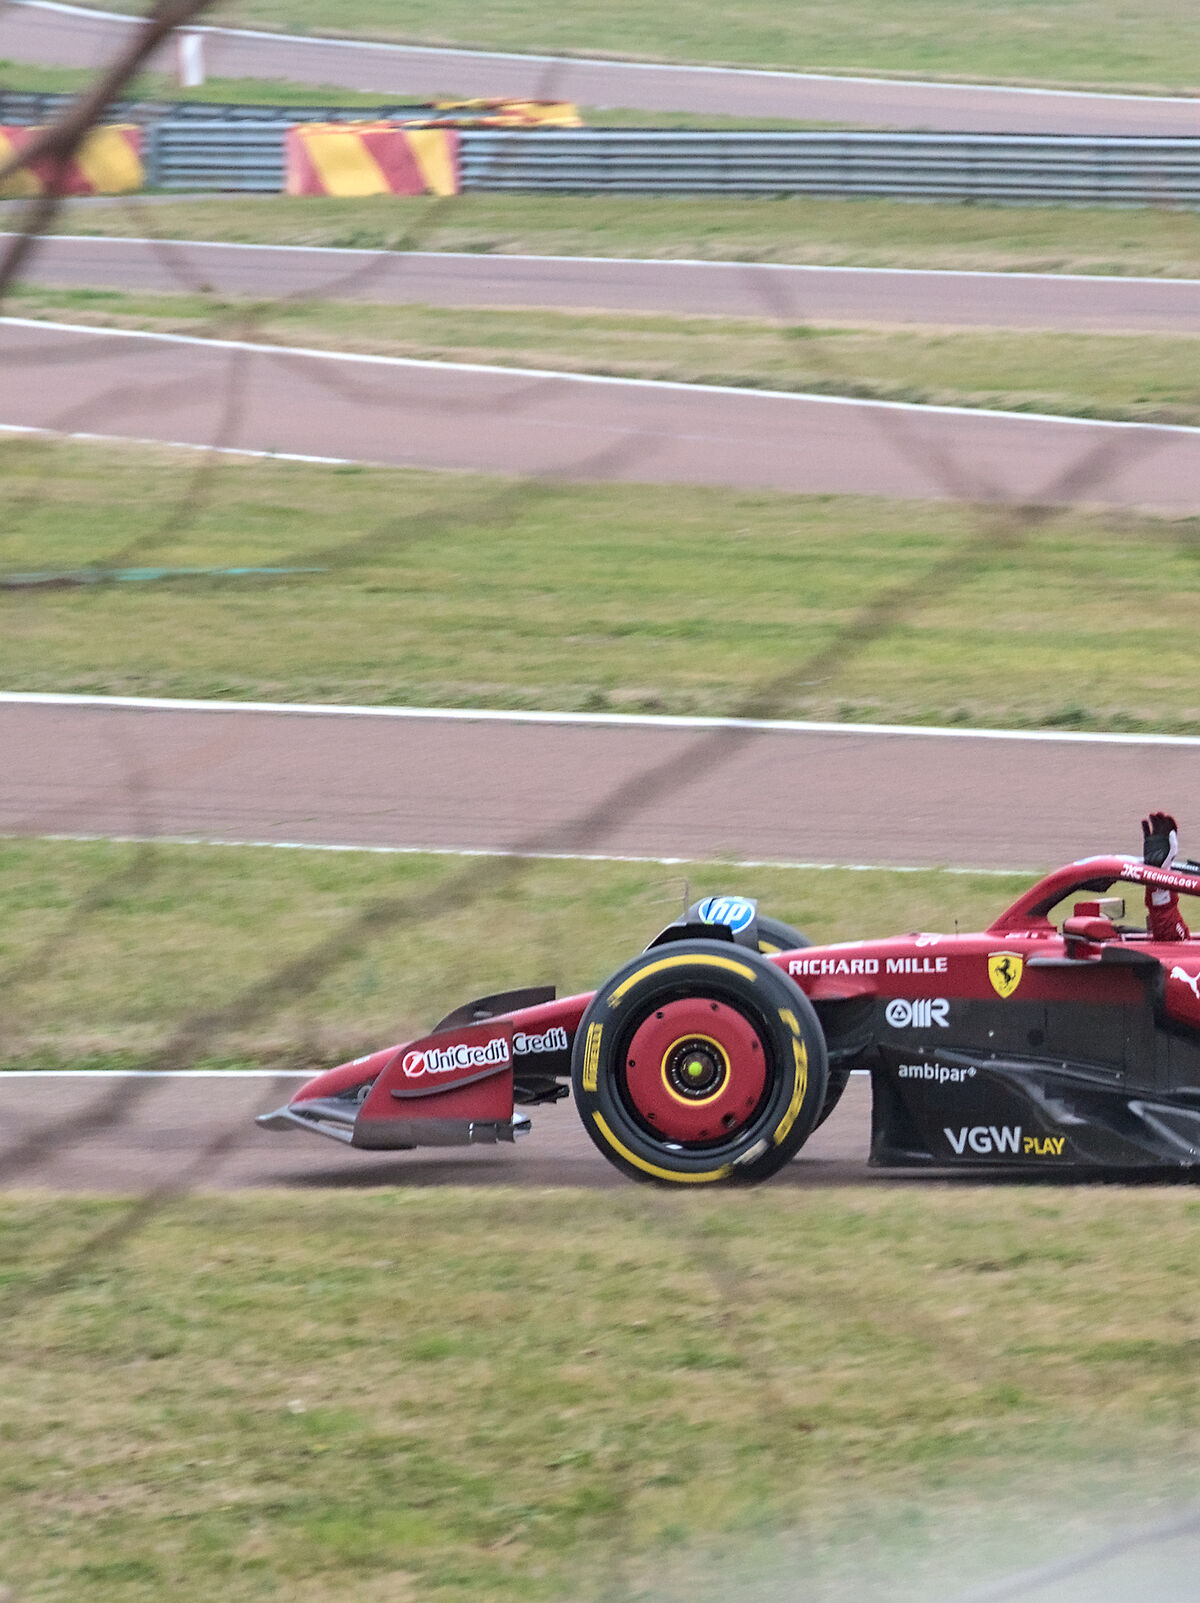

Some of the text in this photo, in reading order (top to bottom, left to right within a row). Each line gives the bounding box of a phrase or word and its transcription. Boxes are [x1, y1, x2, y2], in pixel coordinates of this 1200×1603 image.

[1143, 870, 1198, 889] TECHNOLOGY
[788, 957, 948, 975] RICHARD MILLE
[425, 1039, 507, 1072] UniCredit
[943, 1126, 1065, 1155] VGW PLAY
